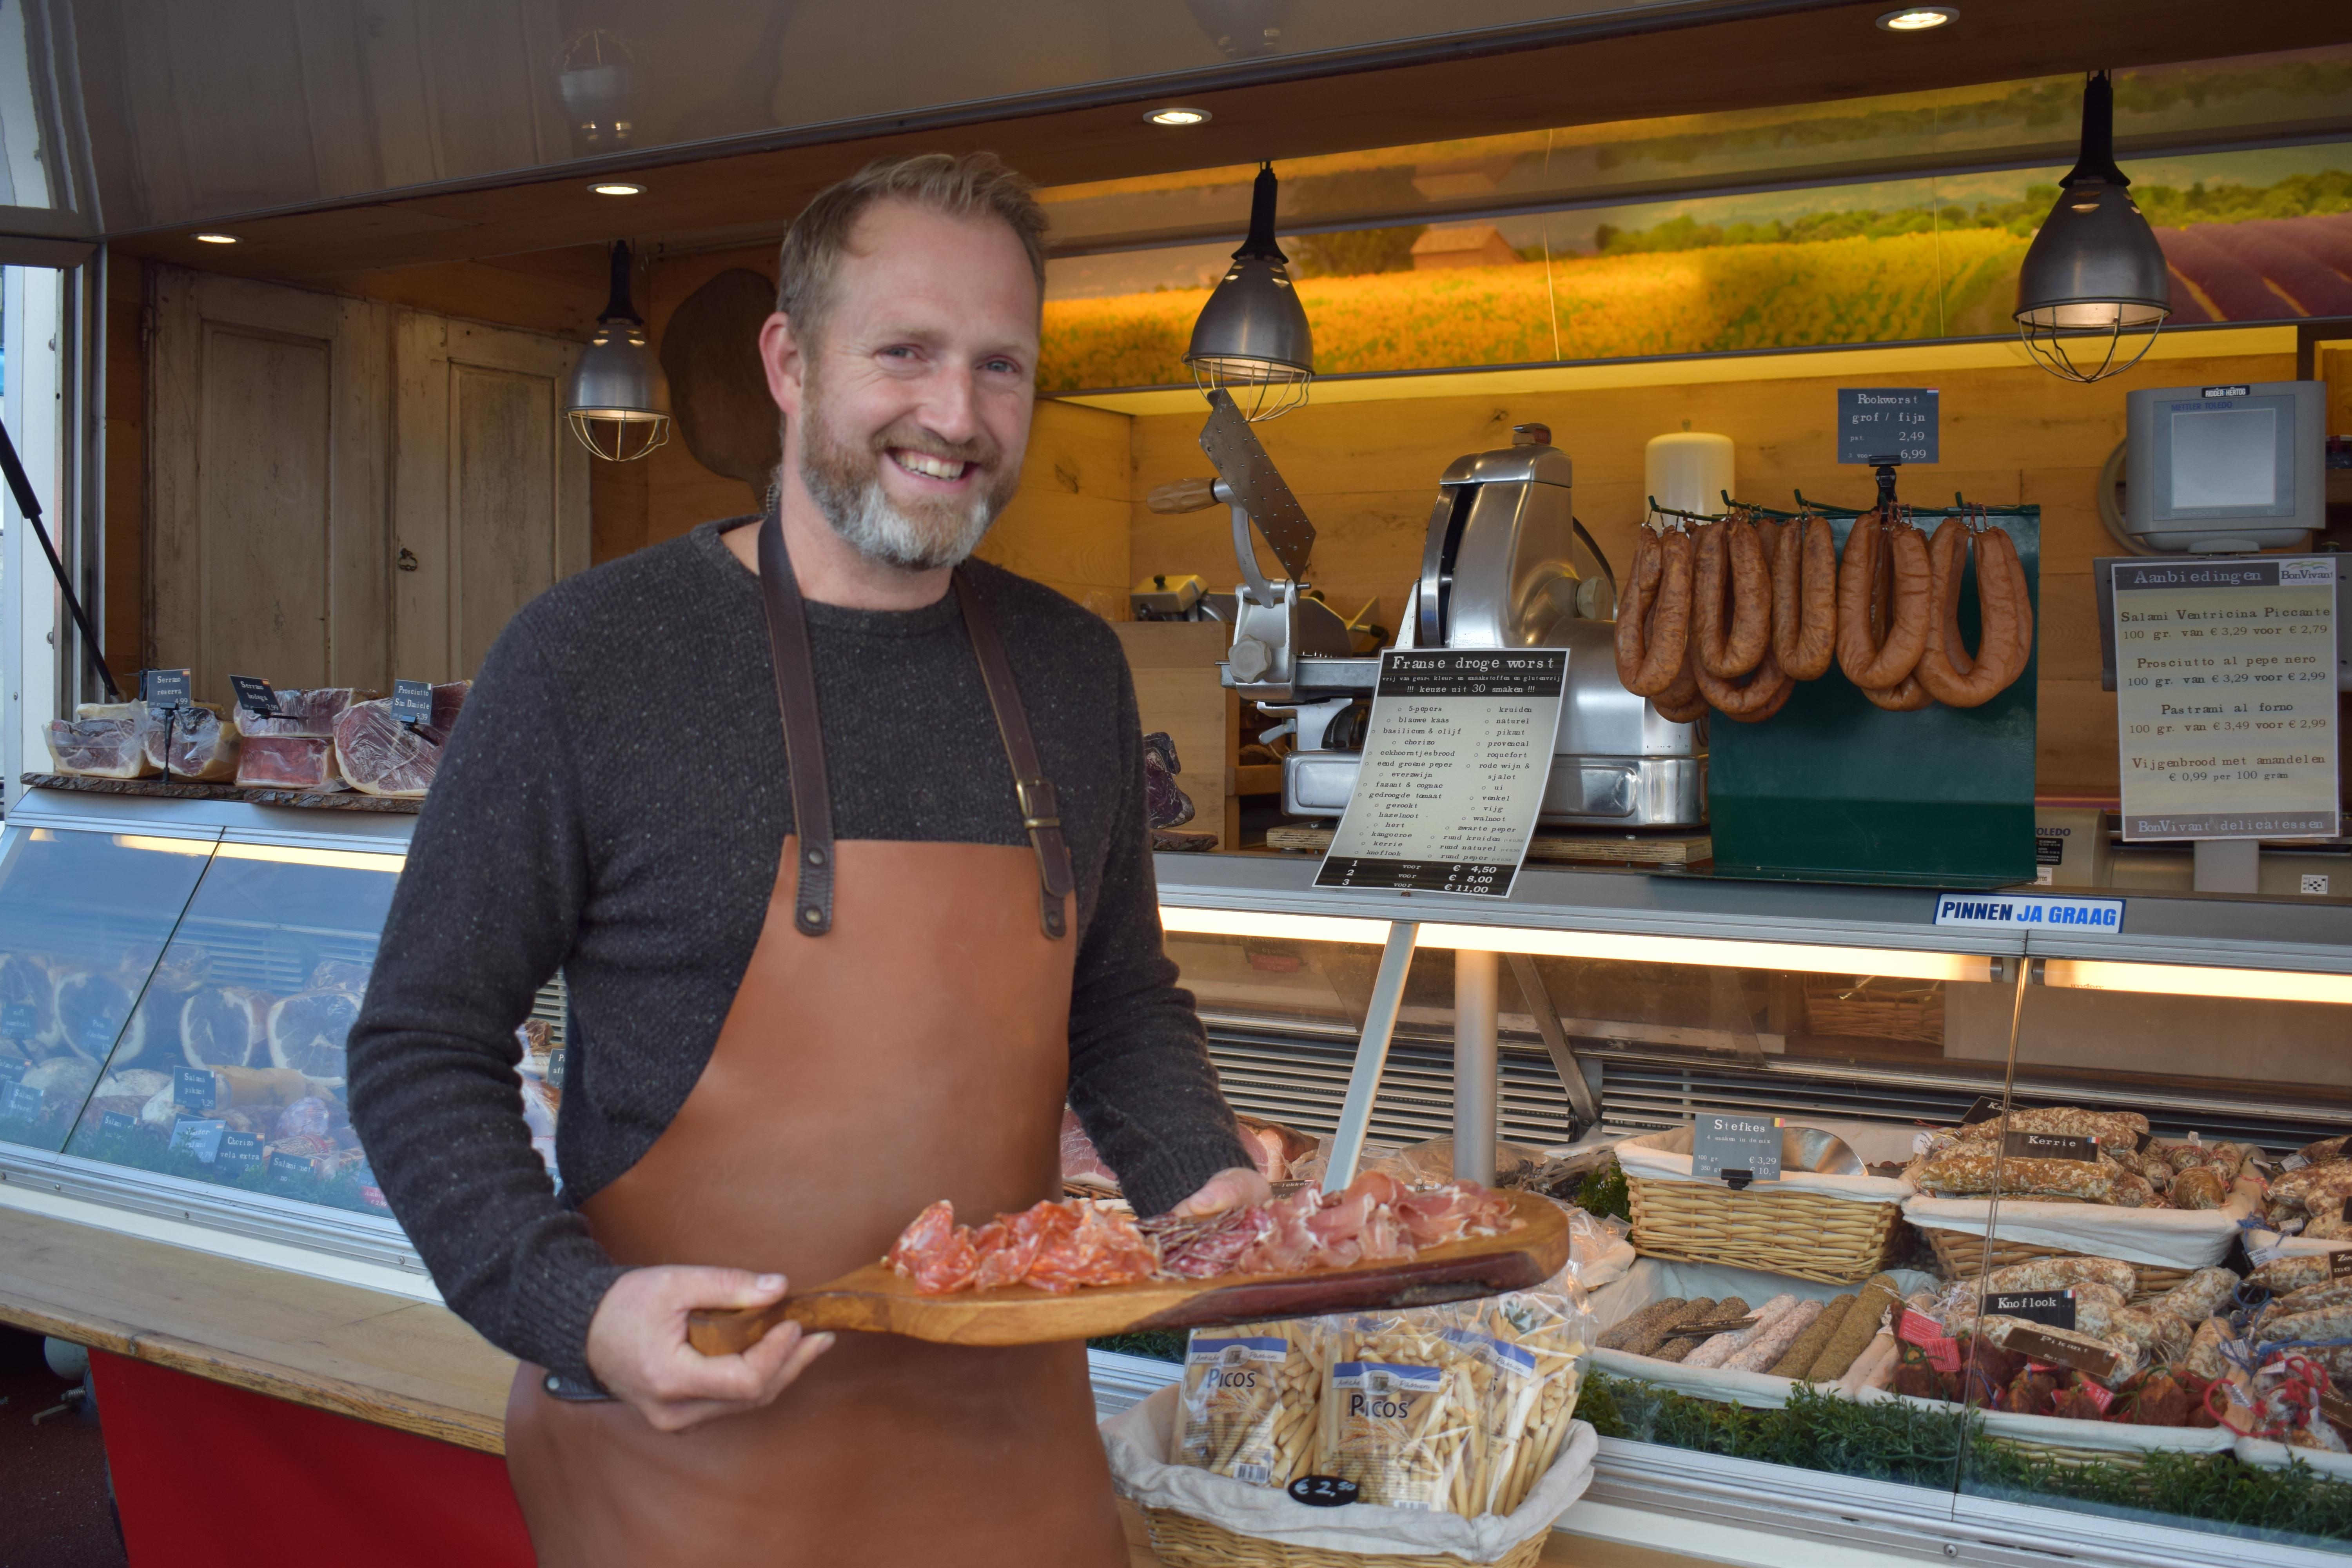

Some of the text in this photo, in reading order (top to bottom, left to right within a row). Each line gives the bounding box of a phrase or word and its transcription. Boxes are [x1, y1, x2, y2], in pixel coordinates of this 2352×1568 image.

[1858, 394, 1918, 404] Rookworst
[2205, 401, 2232, 410] TOLEDO
[1852, 412, 1879, 424] grof
[1899, 413, 1926, 424] fijn
[1899, 432, 1924, 442] 2,49
[1901, 450, 1926, 460] 6,99
[2134, 570, 2261, 584] Aanbiedingen
[2121, 608, 2330, 622] Salami Ventricina Piccante
[2124, 631, 2144, 639] 100
[2153, 630, 2171, 641] gr.
[2221, 627, 2247, 637] 3,29
[2301, 625, 2327, 635] 2,79
[1392, 656, 1553, 671] Franse droge worst
[2137, 658, 2214, 668] Prosciutto
[2223, 656, 2237, 665] al
[2246, 657, 2278, 667] pepe
[241, 681, 264, 690] Serrano
[398, 686, 429, 696] Prosciutto
[1472, 684, 1485, 693] 30
[247, 693, 268, 701] bodega
[407, 699, 430, 709] Daniele
[2161, 703, 2293, 715] Pastrami al forno
[2132, 755, 2325, 770] Vijgenbrood met amandelen
[2036, 827, 2071, 836] OLEDO
[2138, 820, 2323, 832] BonVivant delicatessen
[1941, 901, 2117, 926] PINNEN JA GRAAG
[185, 1073, 205, 1082] Salami
[15, 1089, 34, 1100] Salami
[105, 1116, 122, 1127] Salami
[1714, 1119, 1765, 1132] Stefkes
[228, 1137, 254, 1146] Chorizo
[2028, 1136, 2076, 1147] Kerrie
[274, 1158, 296, 1169] Salami
[1759, 1167, 1775, 1176] 10,-
[1998, 1298, 2056, 1308] Knoflook
[2040, 1336, 2089, 1352] Pikant
[1249, 1352, 1278, 1360] Passioni
[1496, 1356, 1524, 1373] Passioni
[1399, 1380, 1430, 1389] Passioni
[1295, 1479, 1310, 1494] €
